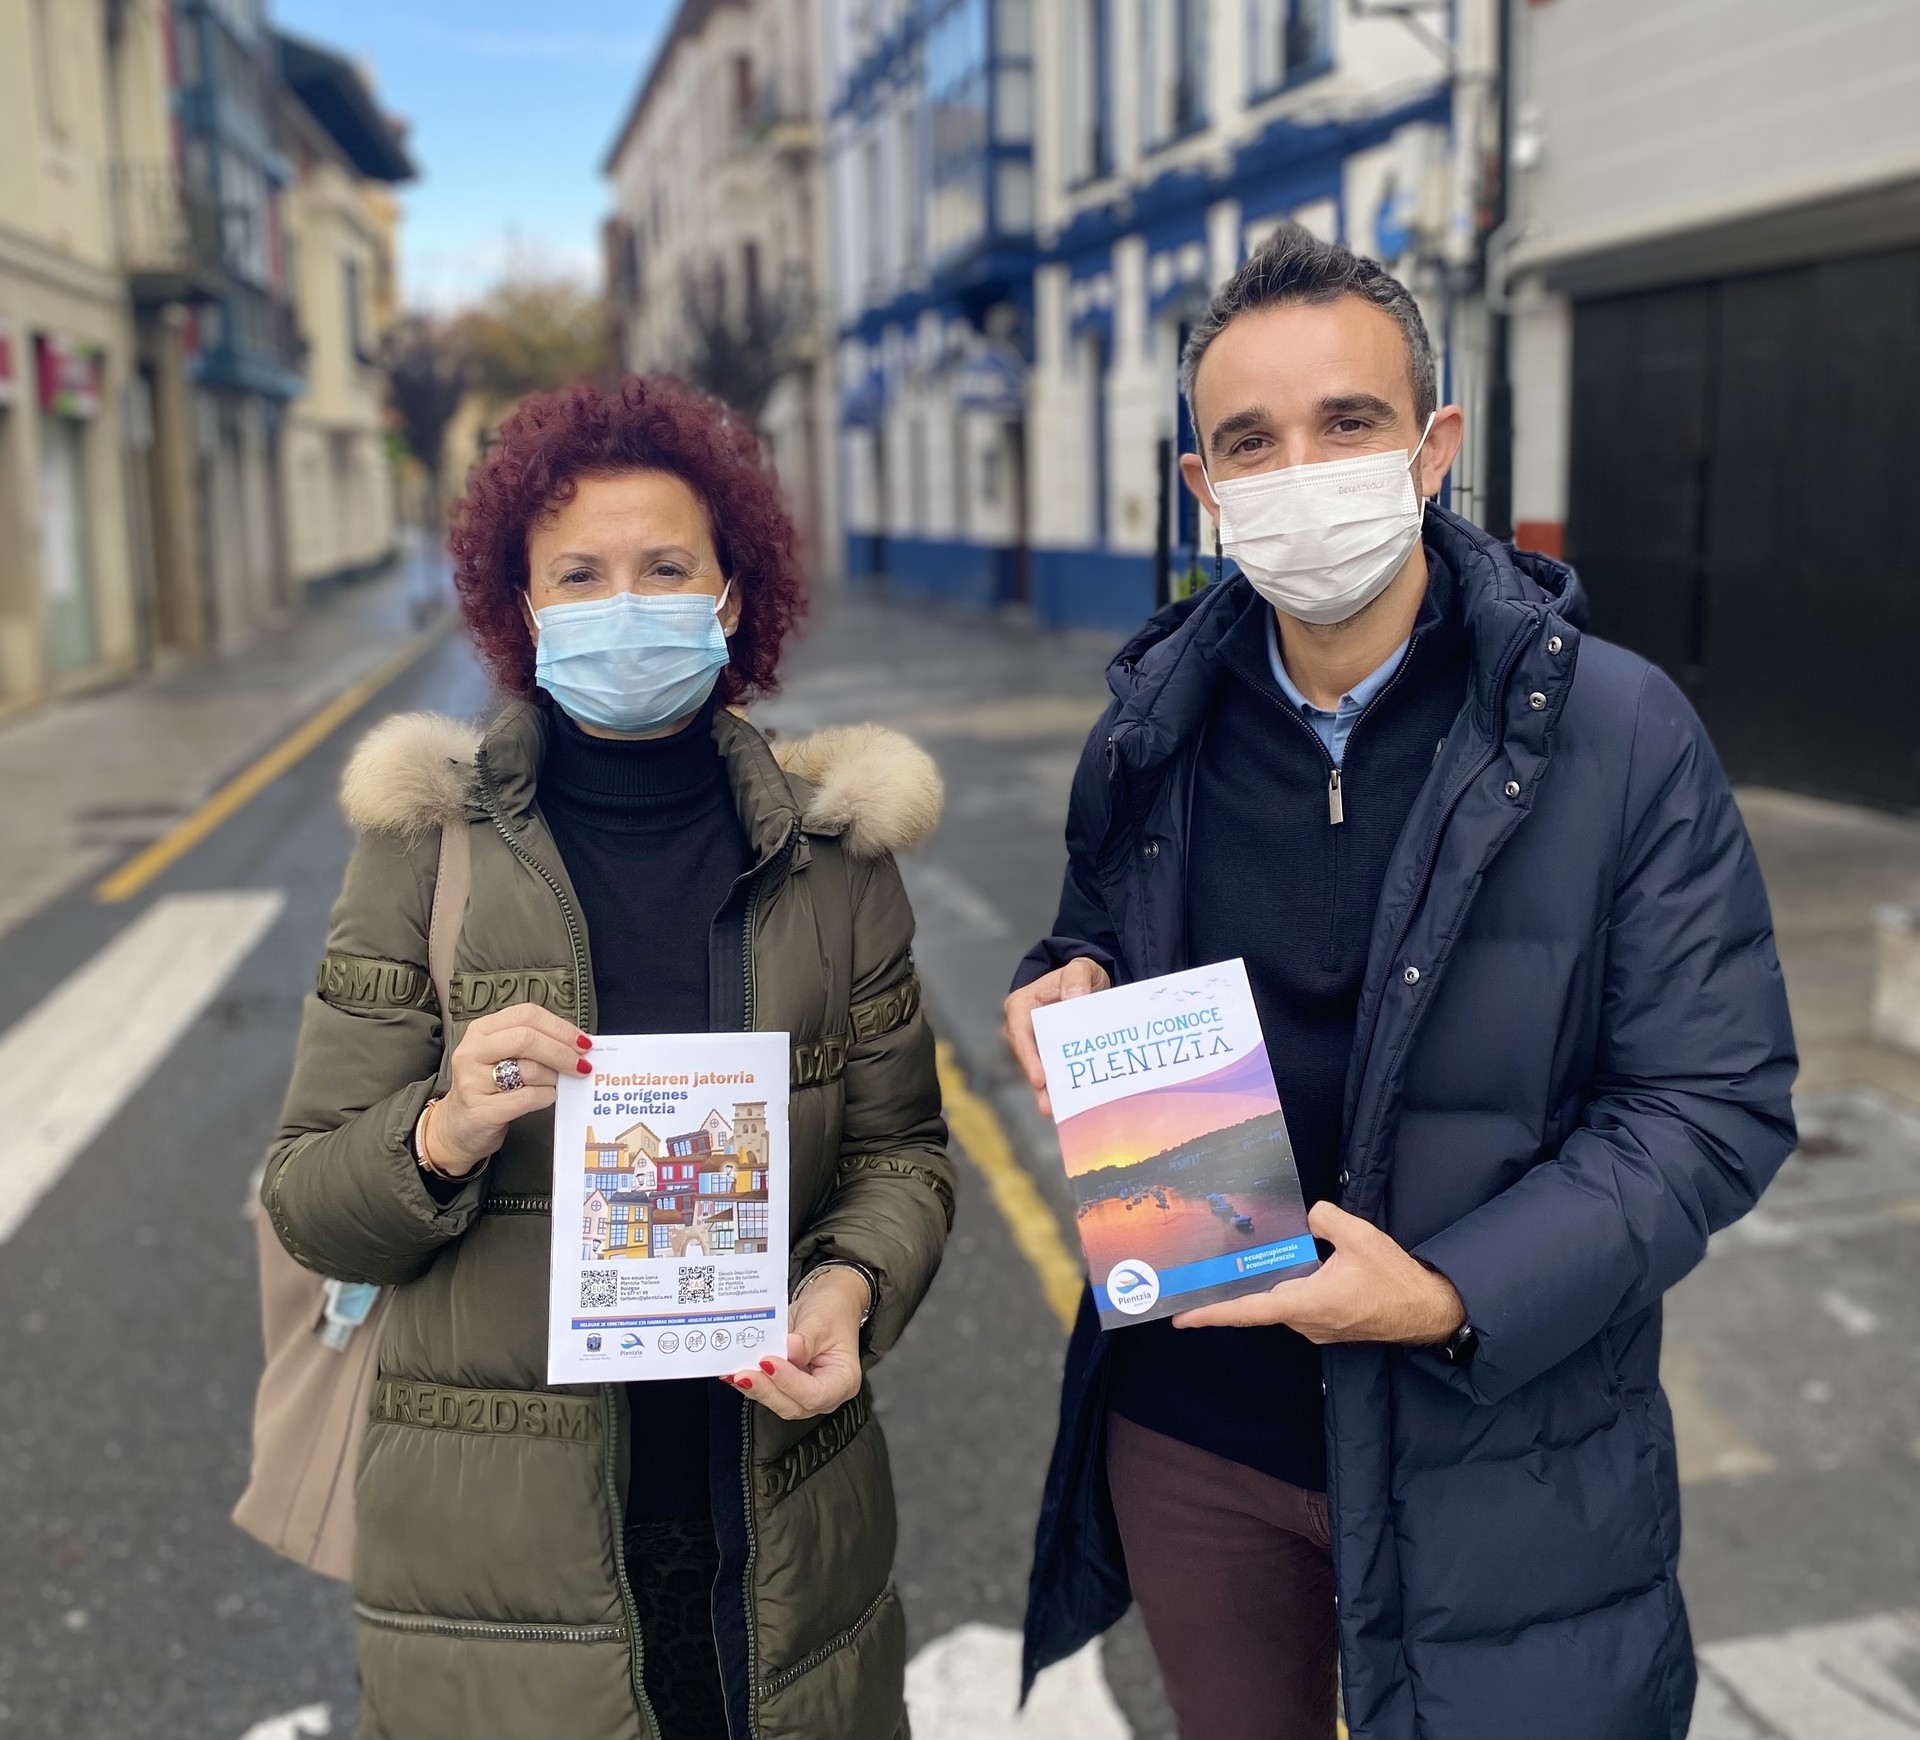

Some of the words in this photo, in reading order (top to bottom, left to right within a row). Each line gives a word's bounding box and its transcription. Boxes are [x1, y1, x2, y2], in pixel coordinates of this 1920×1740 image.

[1062, 1026, 1139, 1059] EZAGUTU
[1066, 1027, 1234, 1090] PLENTZIA
[594, 1073, 689, 1087] Plentziaren
[693, 1071, 755, 1088] jatorria
[594, 1089, 620, 1102] Los
[624, 1088, 688, 1103] orígenes
[593, 1104, 611, 1116] de
[615, 1102, 676, 1115] Plentzia
[592, 1285, 607, 1293] EUS
[690, 1281, 705, 1289] CAS
[1118, 1291, 1152, 1305] Plentzia
